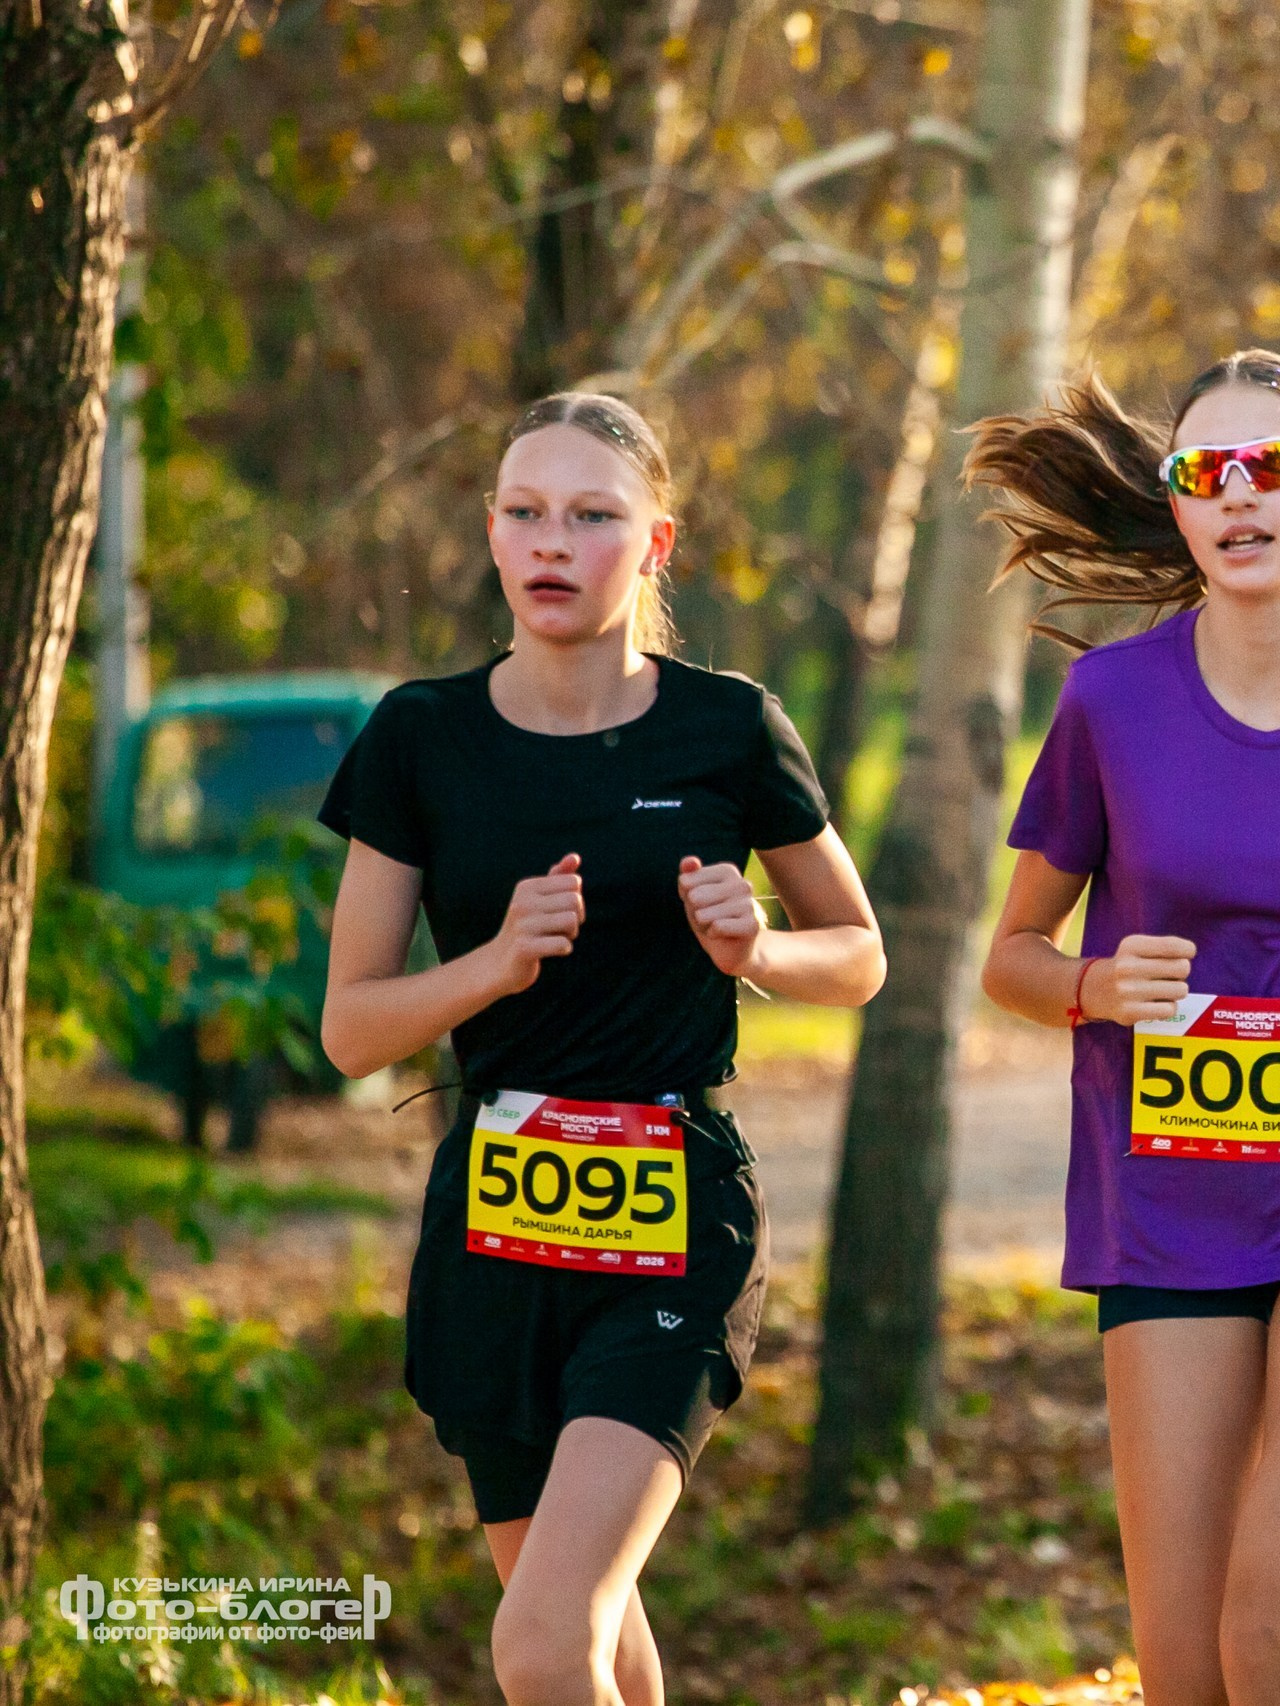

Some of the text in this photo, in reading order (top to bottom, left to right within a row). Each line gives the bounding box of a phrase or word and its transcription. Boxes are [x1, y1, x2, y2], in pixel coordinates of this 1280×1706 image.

[1235, 1020, 1275, 1031] МОСТЫ
[542, 1110, 622, 1127] КРАСНОЯРСКИЕ
[1160, 1114, 1259, 1132] КЛИМОЧКИНА
[560, 1124, 598, 1134] МОСТЫ
[645, 1125, 652, 1135] 5
[478, 1142, 677, 1225] 5095
[512, 1216, 632, 1240] РЫМШИНА ДАРЬЯ
